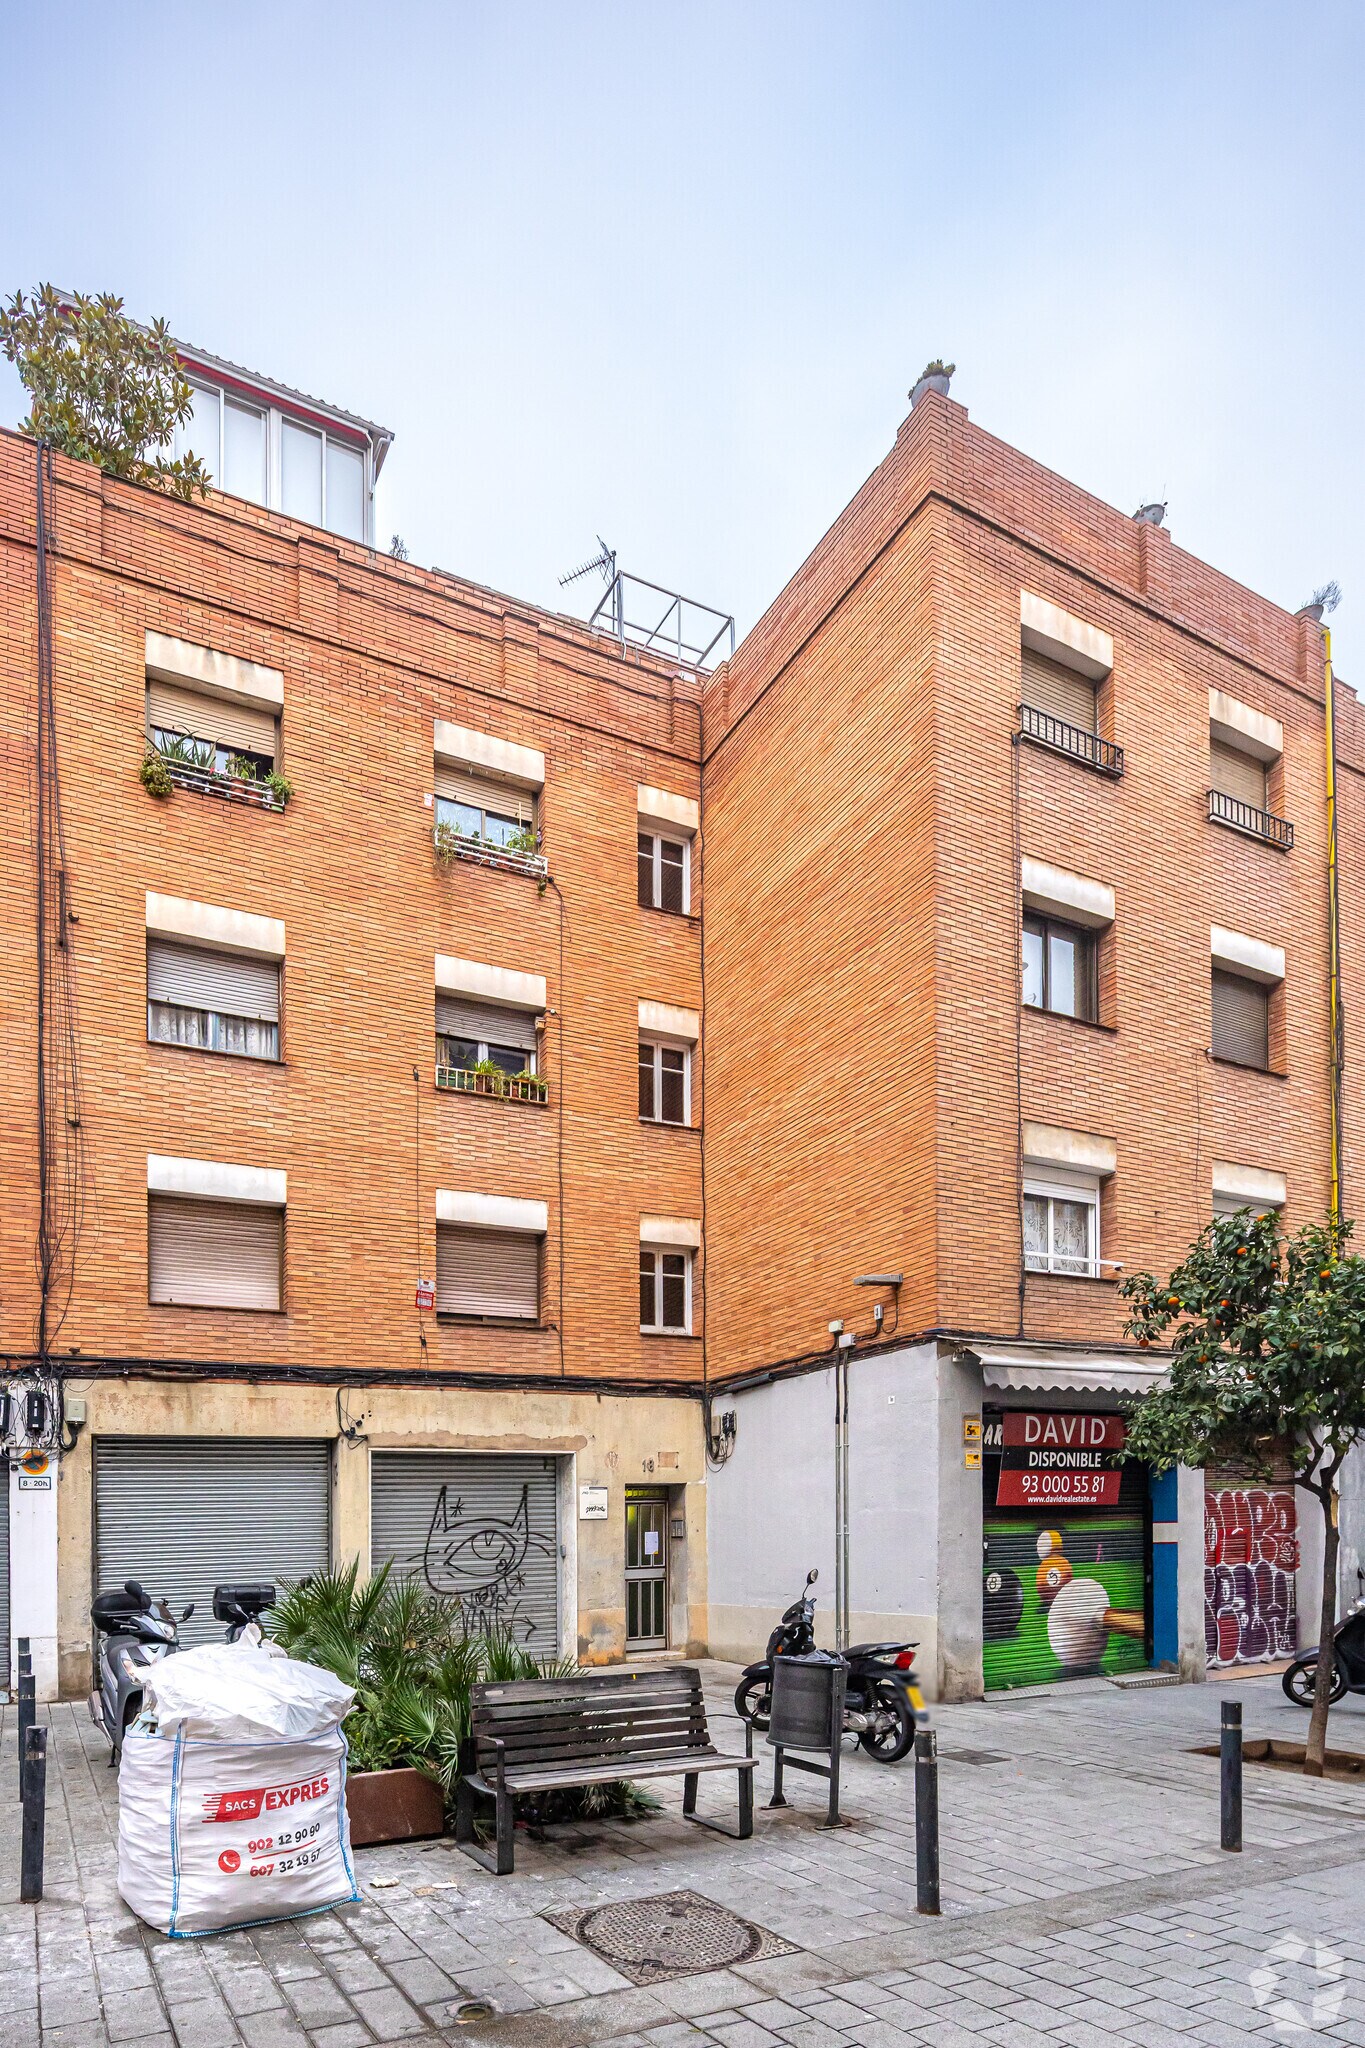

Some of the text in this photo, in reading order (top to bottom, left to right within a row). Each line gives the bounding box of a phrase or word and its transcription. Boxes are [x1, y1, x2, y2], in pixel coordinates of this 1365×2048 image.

[981, 1423, 1003, 1445] AR
[1025, 1415, 1106, 1445] DAVID
[1028, 1451, 1102, 1467] DISPONIBLE
[1022, 1475, 1105, 1493] 93 000 55 81
[1027, 1495, 1097, 1503] www.davidrealestate.es
[225, 1777, 329, 1812] SACS EXPRES
[247, 1822, 321, 1854] 902 12 90 90
[249, 1847, 322, 1877] 607 32 19 57
